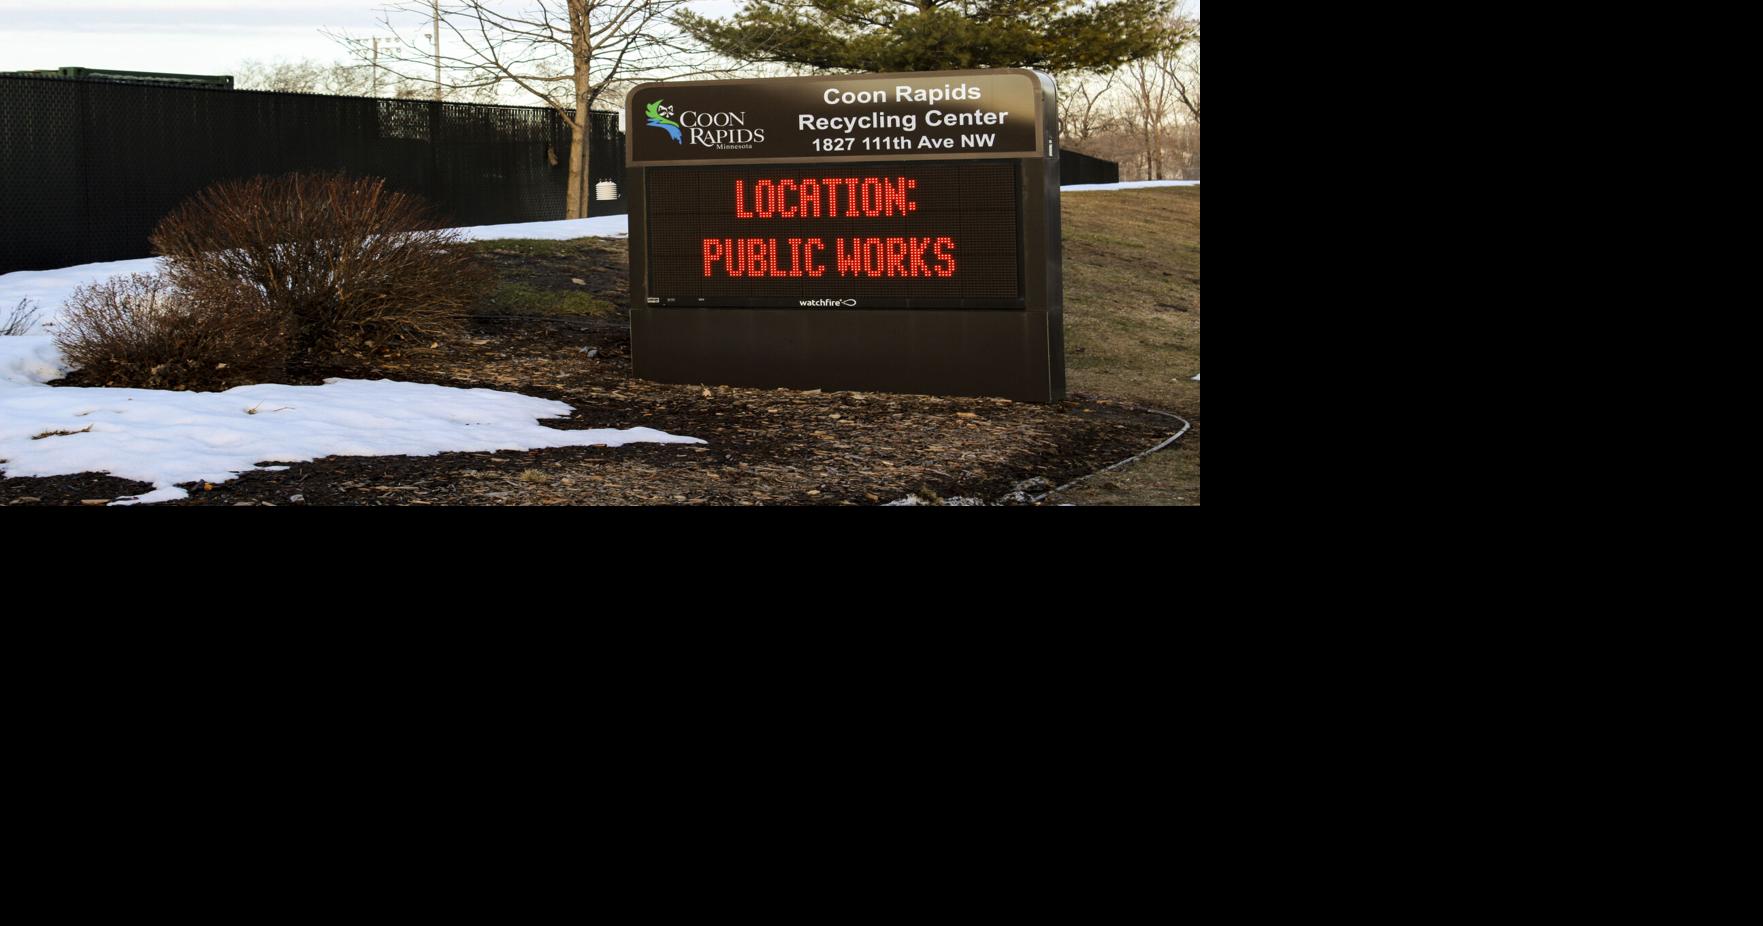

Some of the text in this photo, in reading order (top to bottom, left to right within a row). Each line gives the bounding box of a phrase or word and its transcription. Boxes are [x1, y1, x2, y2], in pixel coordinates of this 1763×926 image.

[823, 82, 982, 105] Coon Rapids
[679, 110, 746, 128] COON
[798, 109, 1009, 134] Recycling Center
[689, 127, 765, 148] RAPIDS
[716, 143, 753, 151] Minnesota
[812, 134, 996, 152] 1827 111th Ave NW
[735, 176, 918, 219] LOCATION:
[703, 237, 956, 278] PUBLIC WORKS
